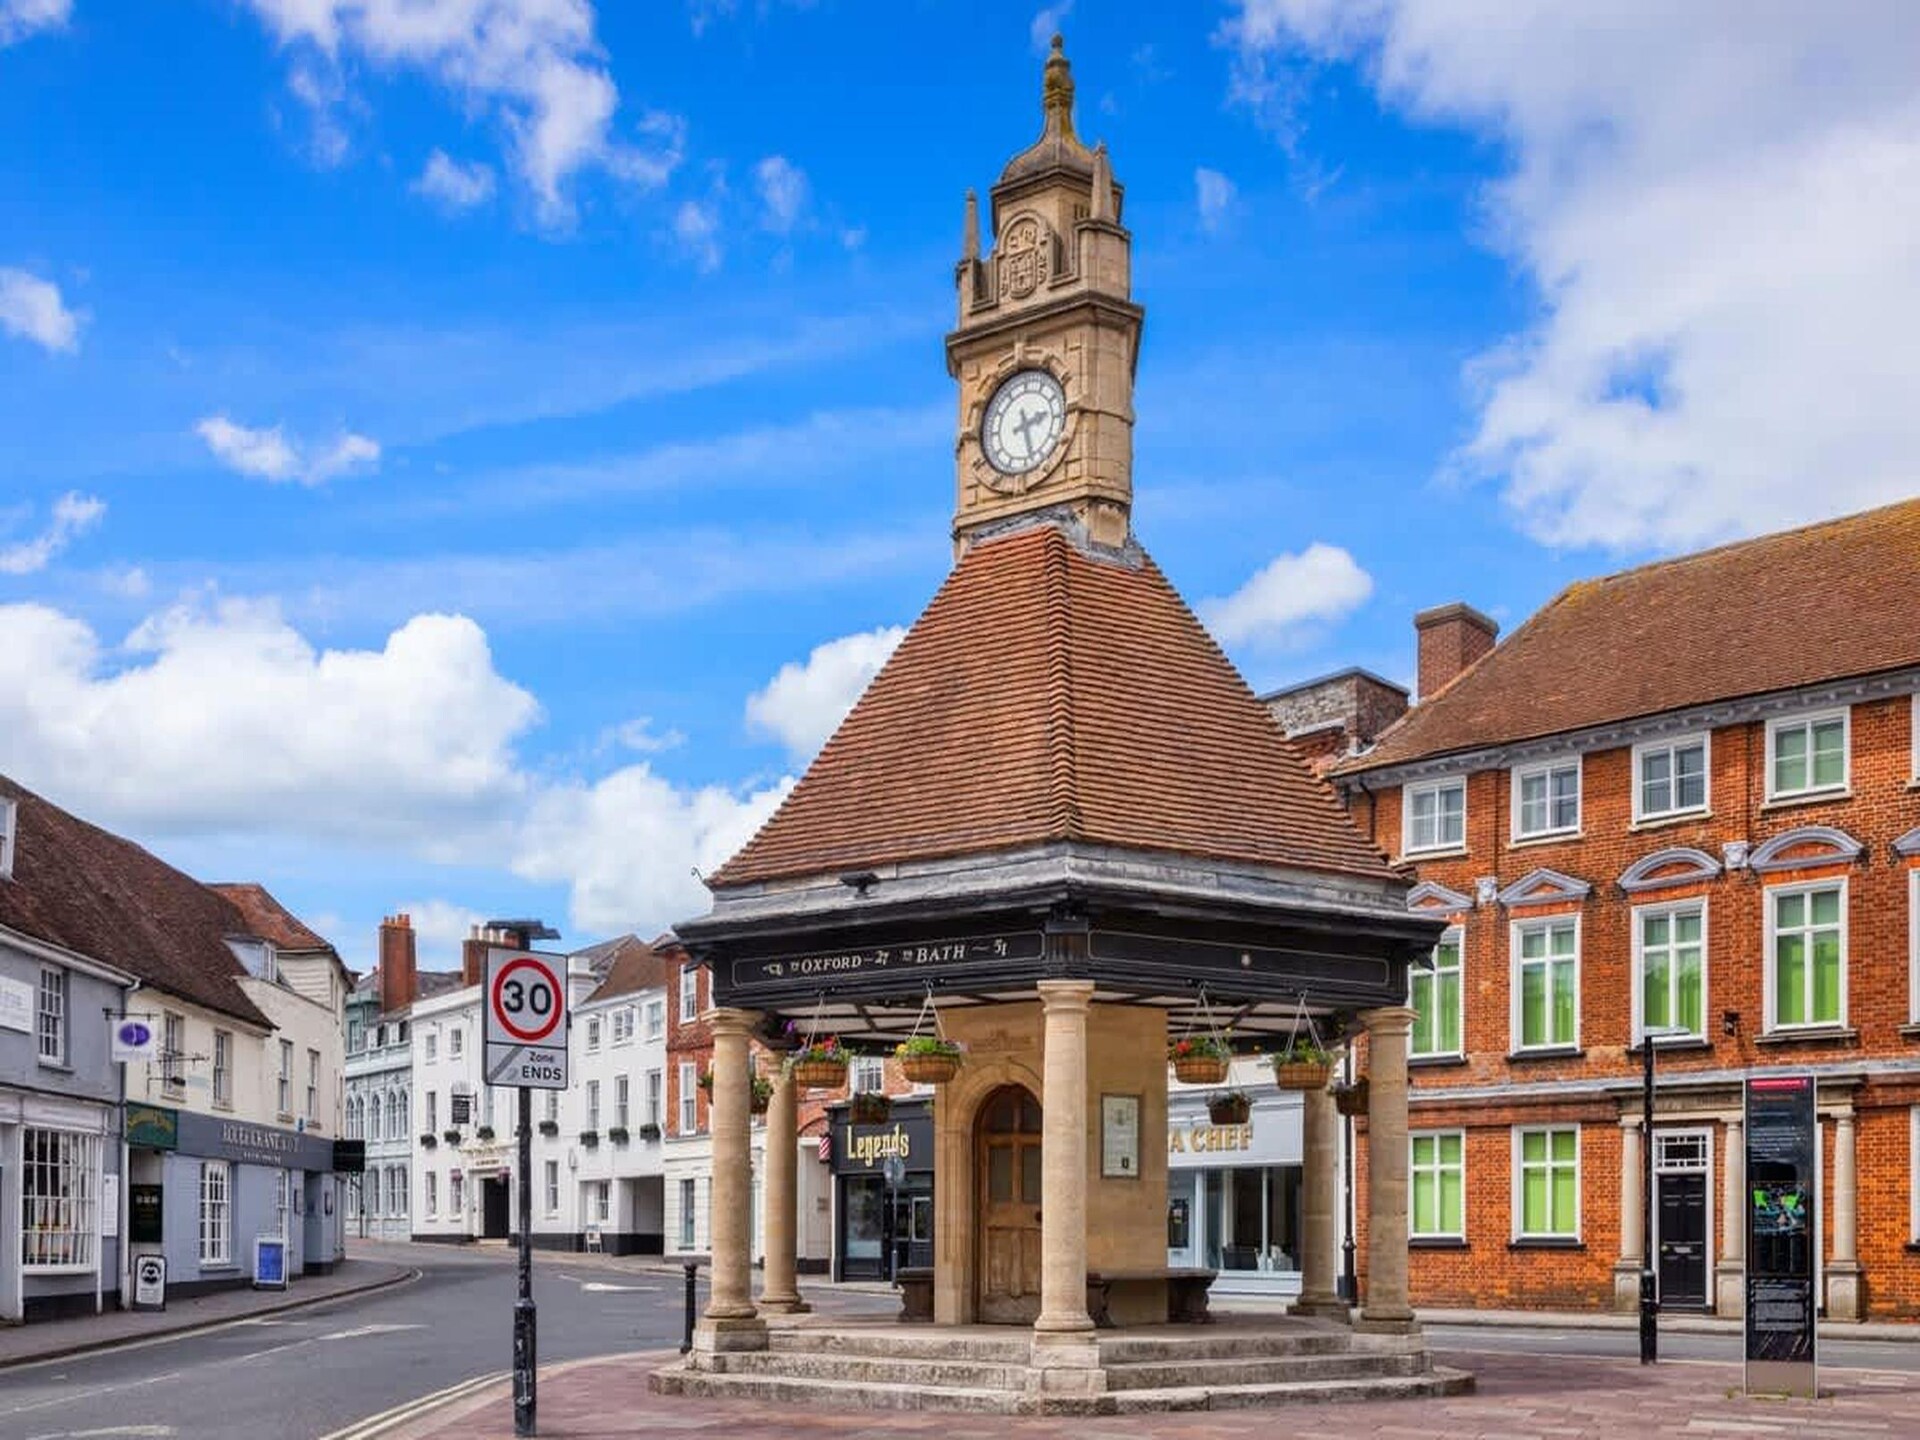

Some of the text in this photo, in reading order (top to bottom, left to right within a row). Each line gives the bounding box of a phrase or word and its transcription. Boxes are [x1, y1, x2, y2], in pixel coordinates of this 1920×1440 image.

[801, 955, 862, 974] OXFORD
[916, 944, 966, 964] BATH
[503, 979, 552, 1016] 30
[529, 1050, 555, 1064] Zone
[521, 1065, 563, 1082] ENDS
[846, 1122, 910, 1168] Legends
[1190, 1124, 1254, 1153] CHEF
